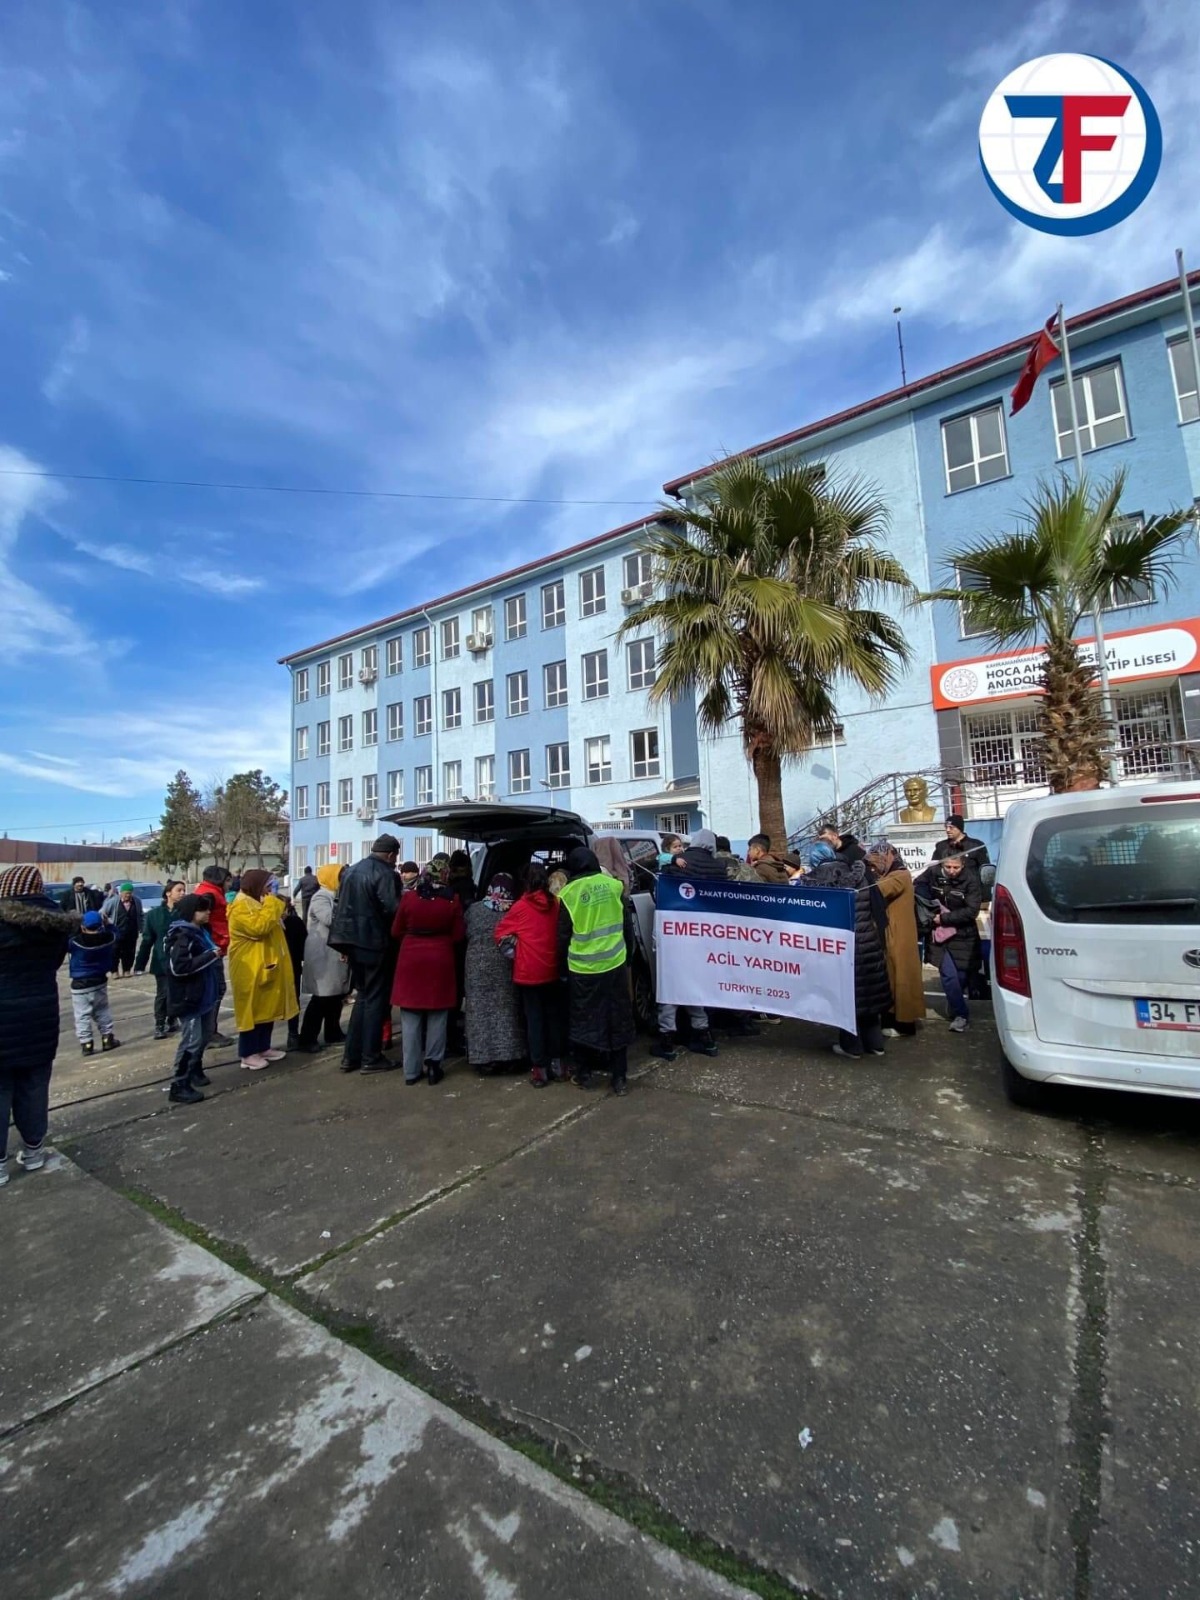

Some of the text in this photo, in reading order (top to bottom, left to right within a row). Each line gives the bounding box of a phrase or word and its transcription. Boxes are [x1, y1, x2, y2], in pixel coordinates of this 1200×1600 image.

[1134, 650, 1176, 668] LİSESİ
[986, 666, 1021, 680] HOCA
[699, 889, 827, 909] ZAKAT FOUNDATION of AMERICA
[663, 921, 847, 955] EMERGENCY RELIEF
[1035, 946, 1078, 957] TOYOTA
[706, 951, 801, 975] ACİL YARDIM
[766, 988, 791, 1000] 2023
[1150, 1002, 1200, 1023] 34 F
